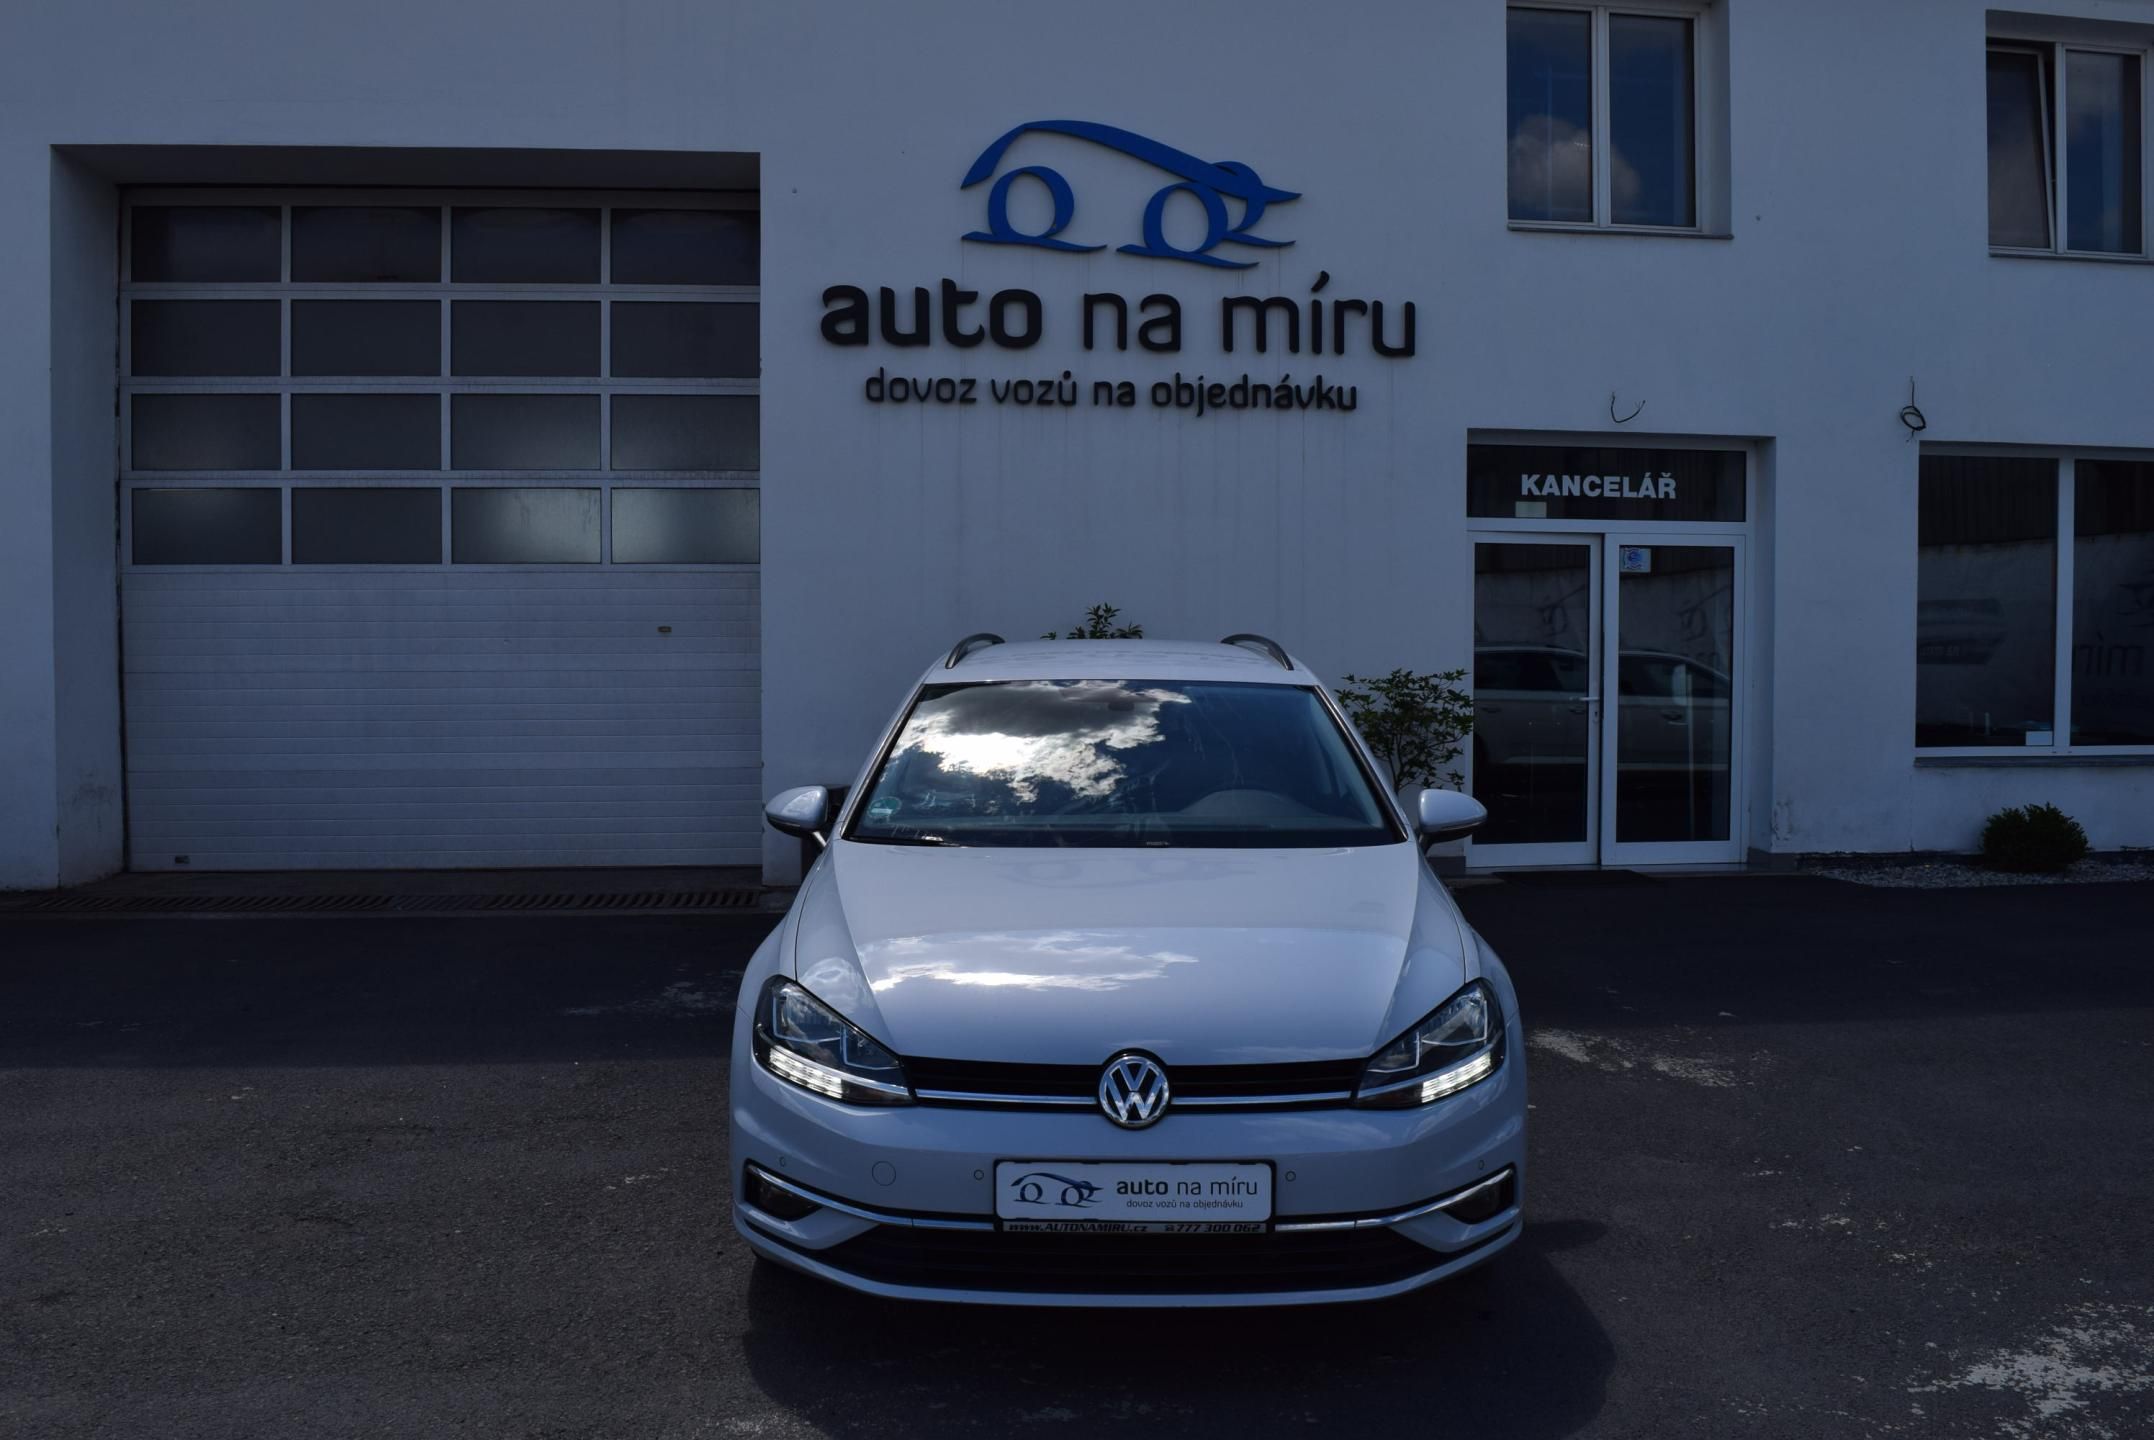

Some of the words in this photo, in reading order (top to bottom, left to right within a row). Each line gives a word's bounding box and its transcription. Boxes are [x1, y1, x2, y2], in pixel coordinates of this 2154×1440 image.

[820, 277, 1043, 349] auto
[1083, 291, 1182, 353] na
[1221, 270, 1416, 357] míru
[865, 366, 978, 403] dovoz
[991, 370, 1078, 406] vozů
[1093, 377, 1136, 407] na
[1150, 373, 1357, 417] objednávku
[1521, 471, 1677, 499] KANCELÁŘ
[1116, 1178, 1169, 1196] auto
[1177, 1181, 1202, 1196] na
[1210, 1175, 1258, 1196] míru
[1126, 1199, 1153, 1208] dovoz
[1156, 1199, 1177, 1209] vozů
[1179, 1201, 1191, 1209] na
[1193, 1199, 1244, 1210] objednávku
[1008, 1223, 1149, 1233] www.AUTONAMIRU.cz
